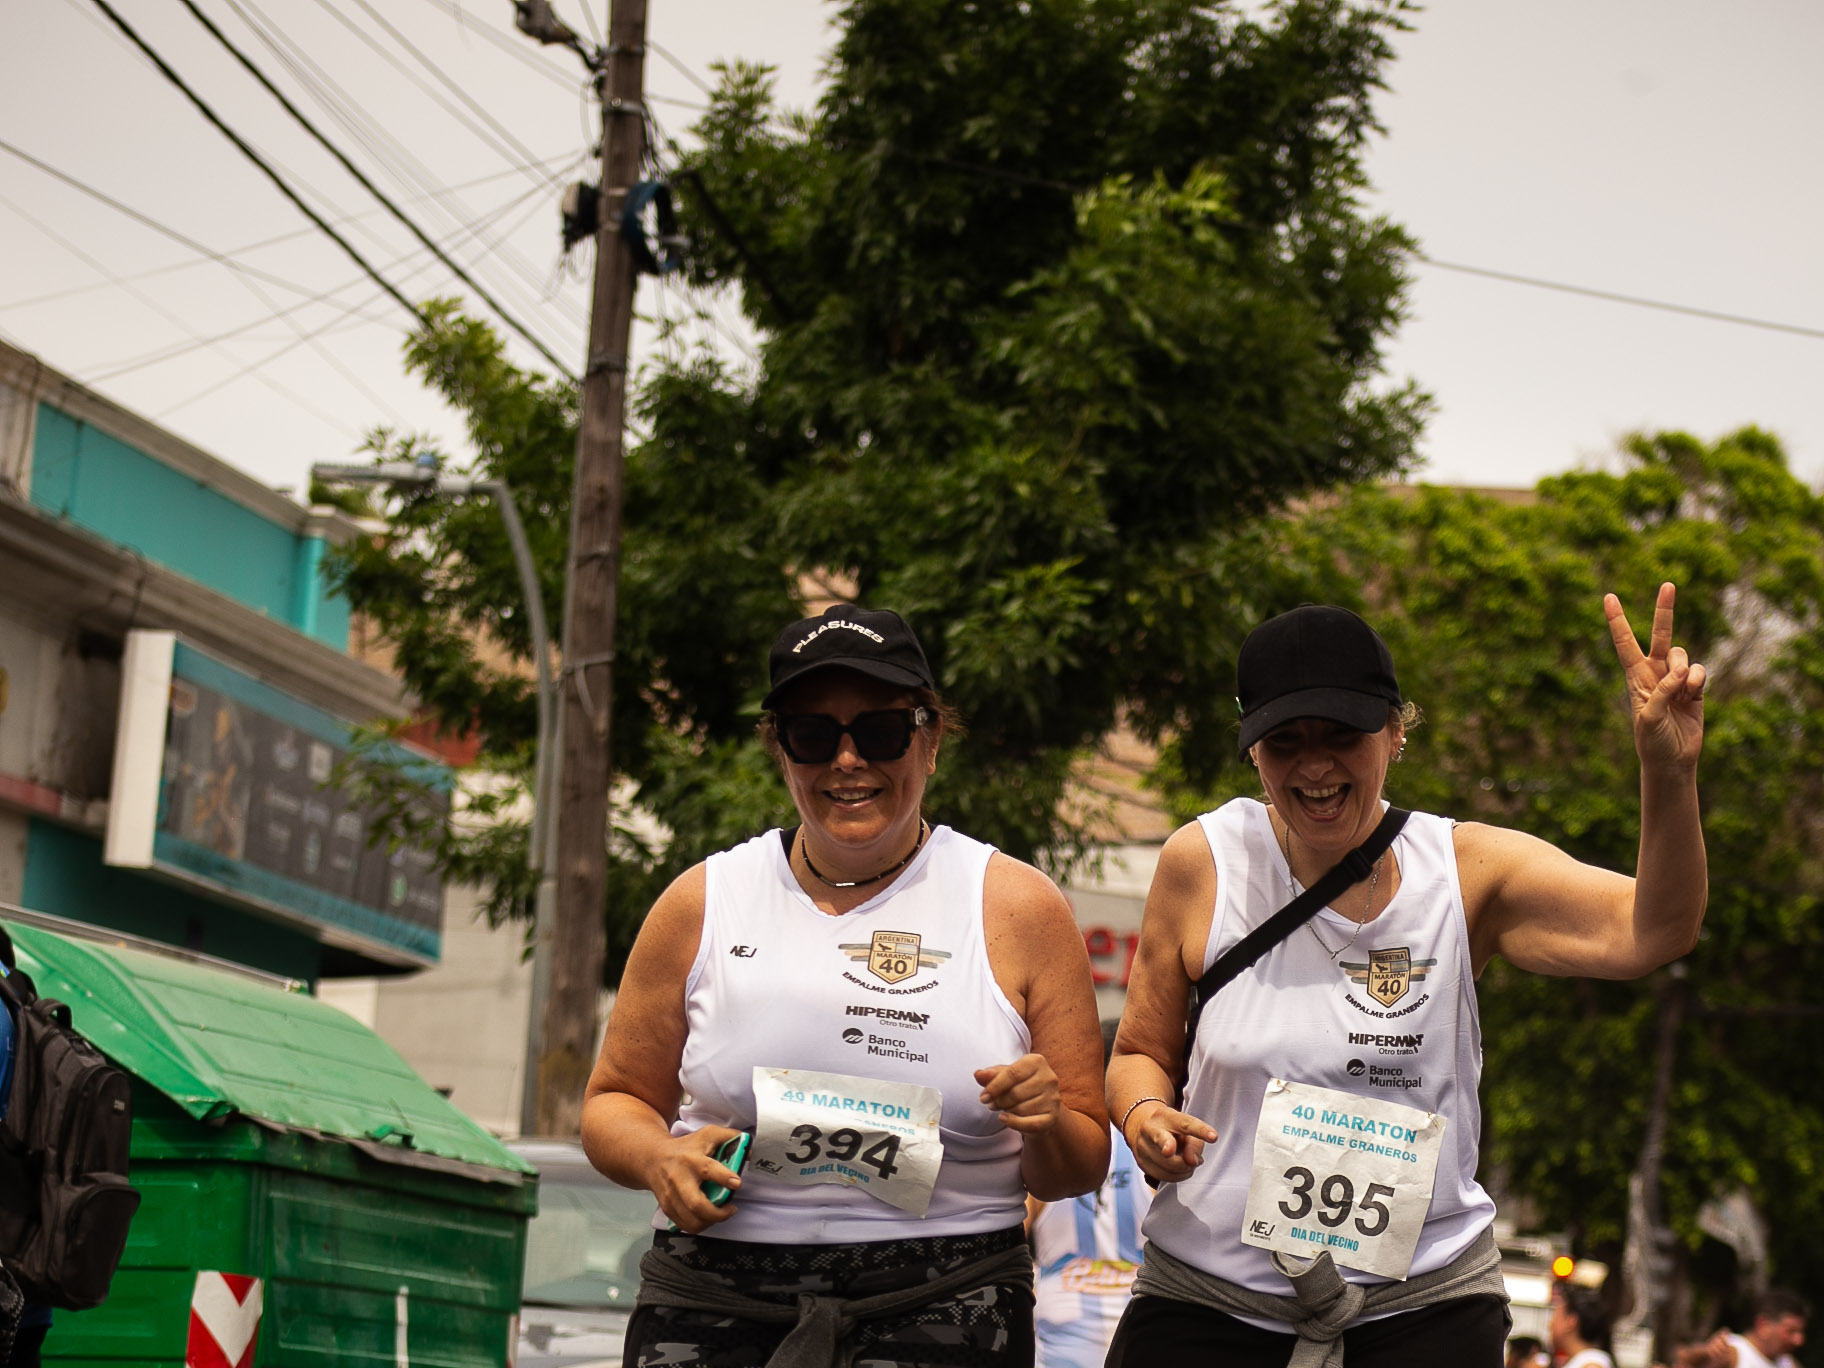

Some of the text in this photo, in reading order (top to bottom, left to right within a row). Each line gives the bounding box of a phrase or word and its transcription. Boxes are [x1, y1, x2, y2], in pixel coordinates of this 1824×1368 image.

[792, 620, 884, 653] PLEASURES
[878, 935, 915, 944] ARGENTINA
[876, 952, 913, 961] MARATÓN
[879, 959, 907, 974] 40
[842, 971, 939, 995] EMPALME GRANEROS
[1374, 972, 1406, 980] MARATÓN
[1377, 979, 1401, 996] 40
[1345, 993, 1430, 1019] EMPALME GRANEROS
[879, 1019, 898, 1027] Otro
[868, 1034, 906, 1048] Banco
[867, 1045, 929, 1063] Municipal
[1378, 1047, 1395, 1056] Otro
[1369, 1065, 1403, 1076] Banco
[1368, 1075, 1422, 1090] Municipal
[783, 1090, 911, 1120] 40 MARATON
[1291, 1104, 1417, 1144] 40 MARATON
[785, 1124, 902, 1180] 394
[1282, 1125, 1418, 1163] EMPALME GRANEROS
[800, 1164, 869, 1183] DIA DEL VECINO
[1278, 1166, 1396, 1237] 395
[1291, 1227, 1359, 1252] DIA DEL VECINO
